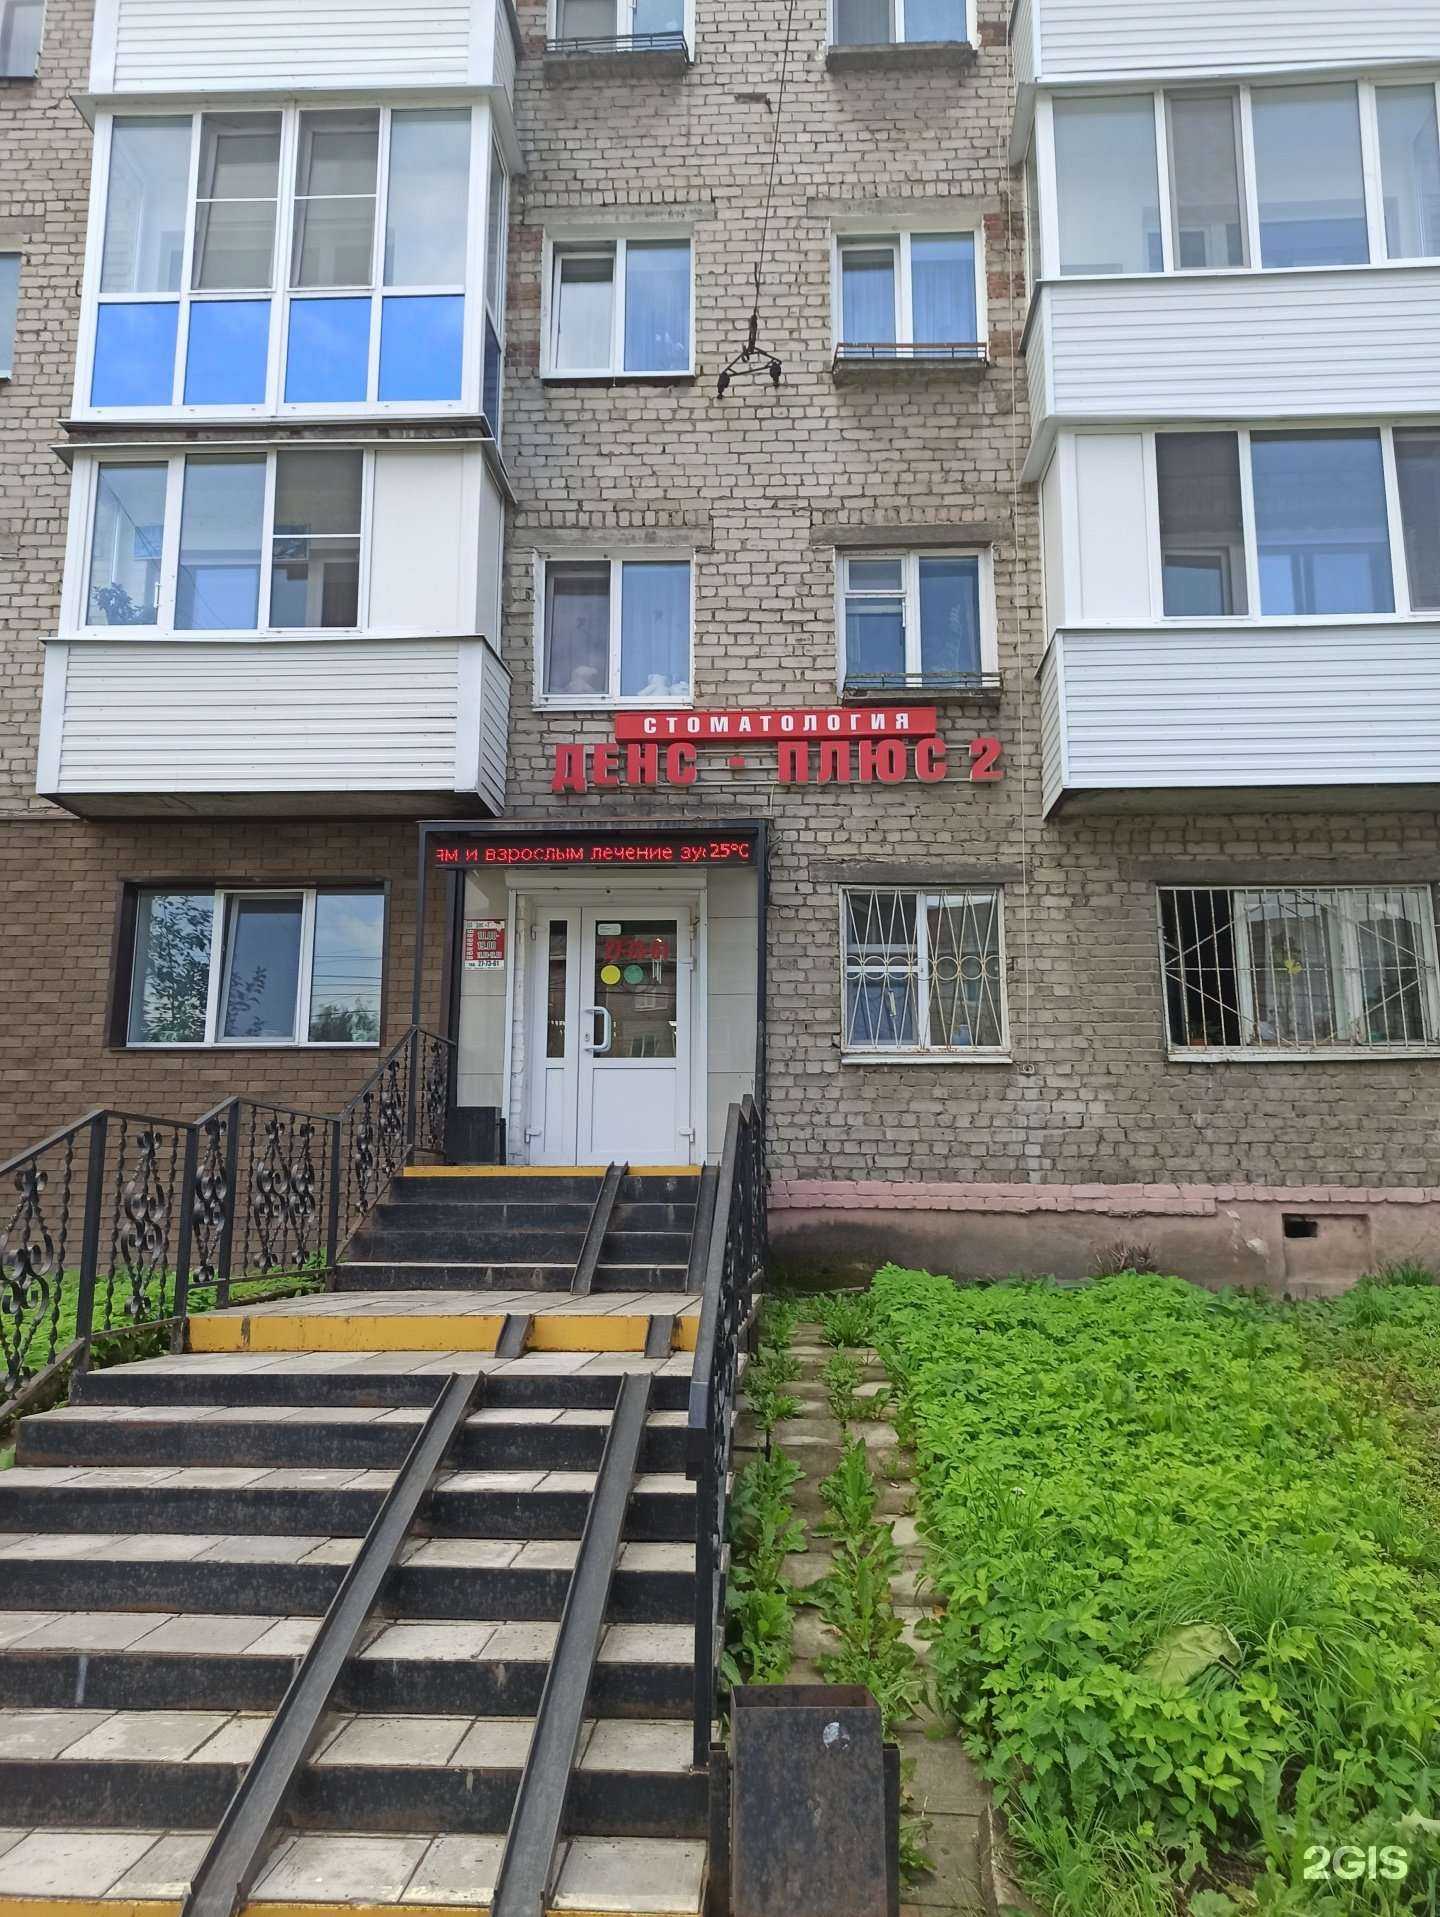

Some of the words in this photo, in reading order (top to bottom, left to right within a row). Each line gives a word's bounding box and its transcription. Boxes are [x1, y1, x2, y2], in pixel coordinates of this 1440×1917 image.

[643, 713, 909, 734] СТОМАТОЛОГИЯ
[551, 742, 698, 793] ДЕНС
[776, 738, 948, 785] ПЛЮС
[968, 737, 1004, 783] 2
[465, 849, 479, 862] и
[484, 848, 584, 863] взрослым
[590, 847, 673, 861] лечение
